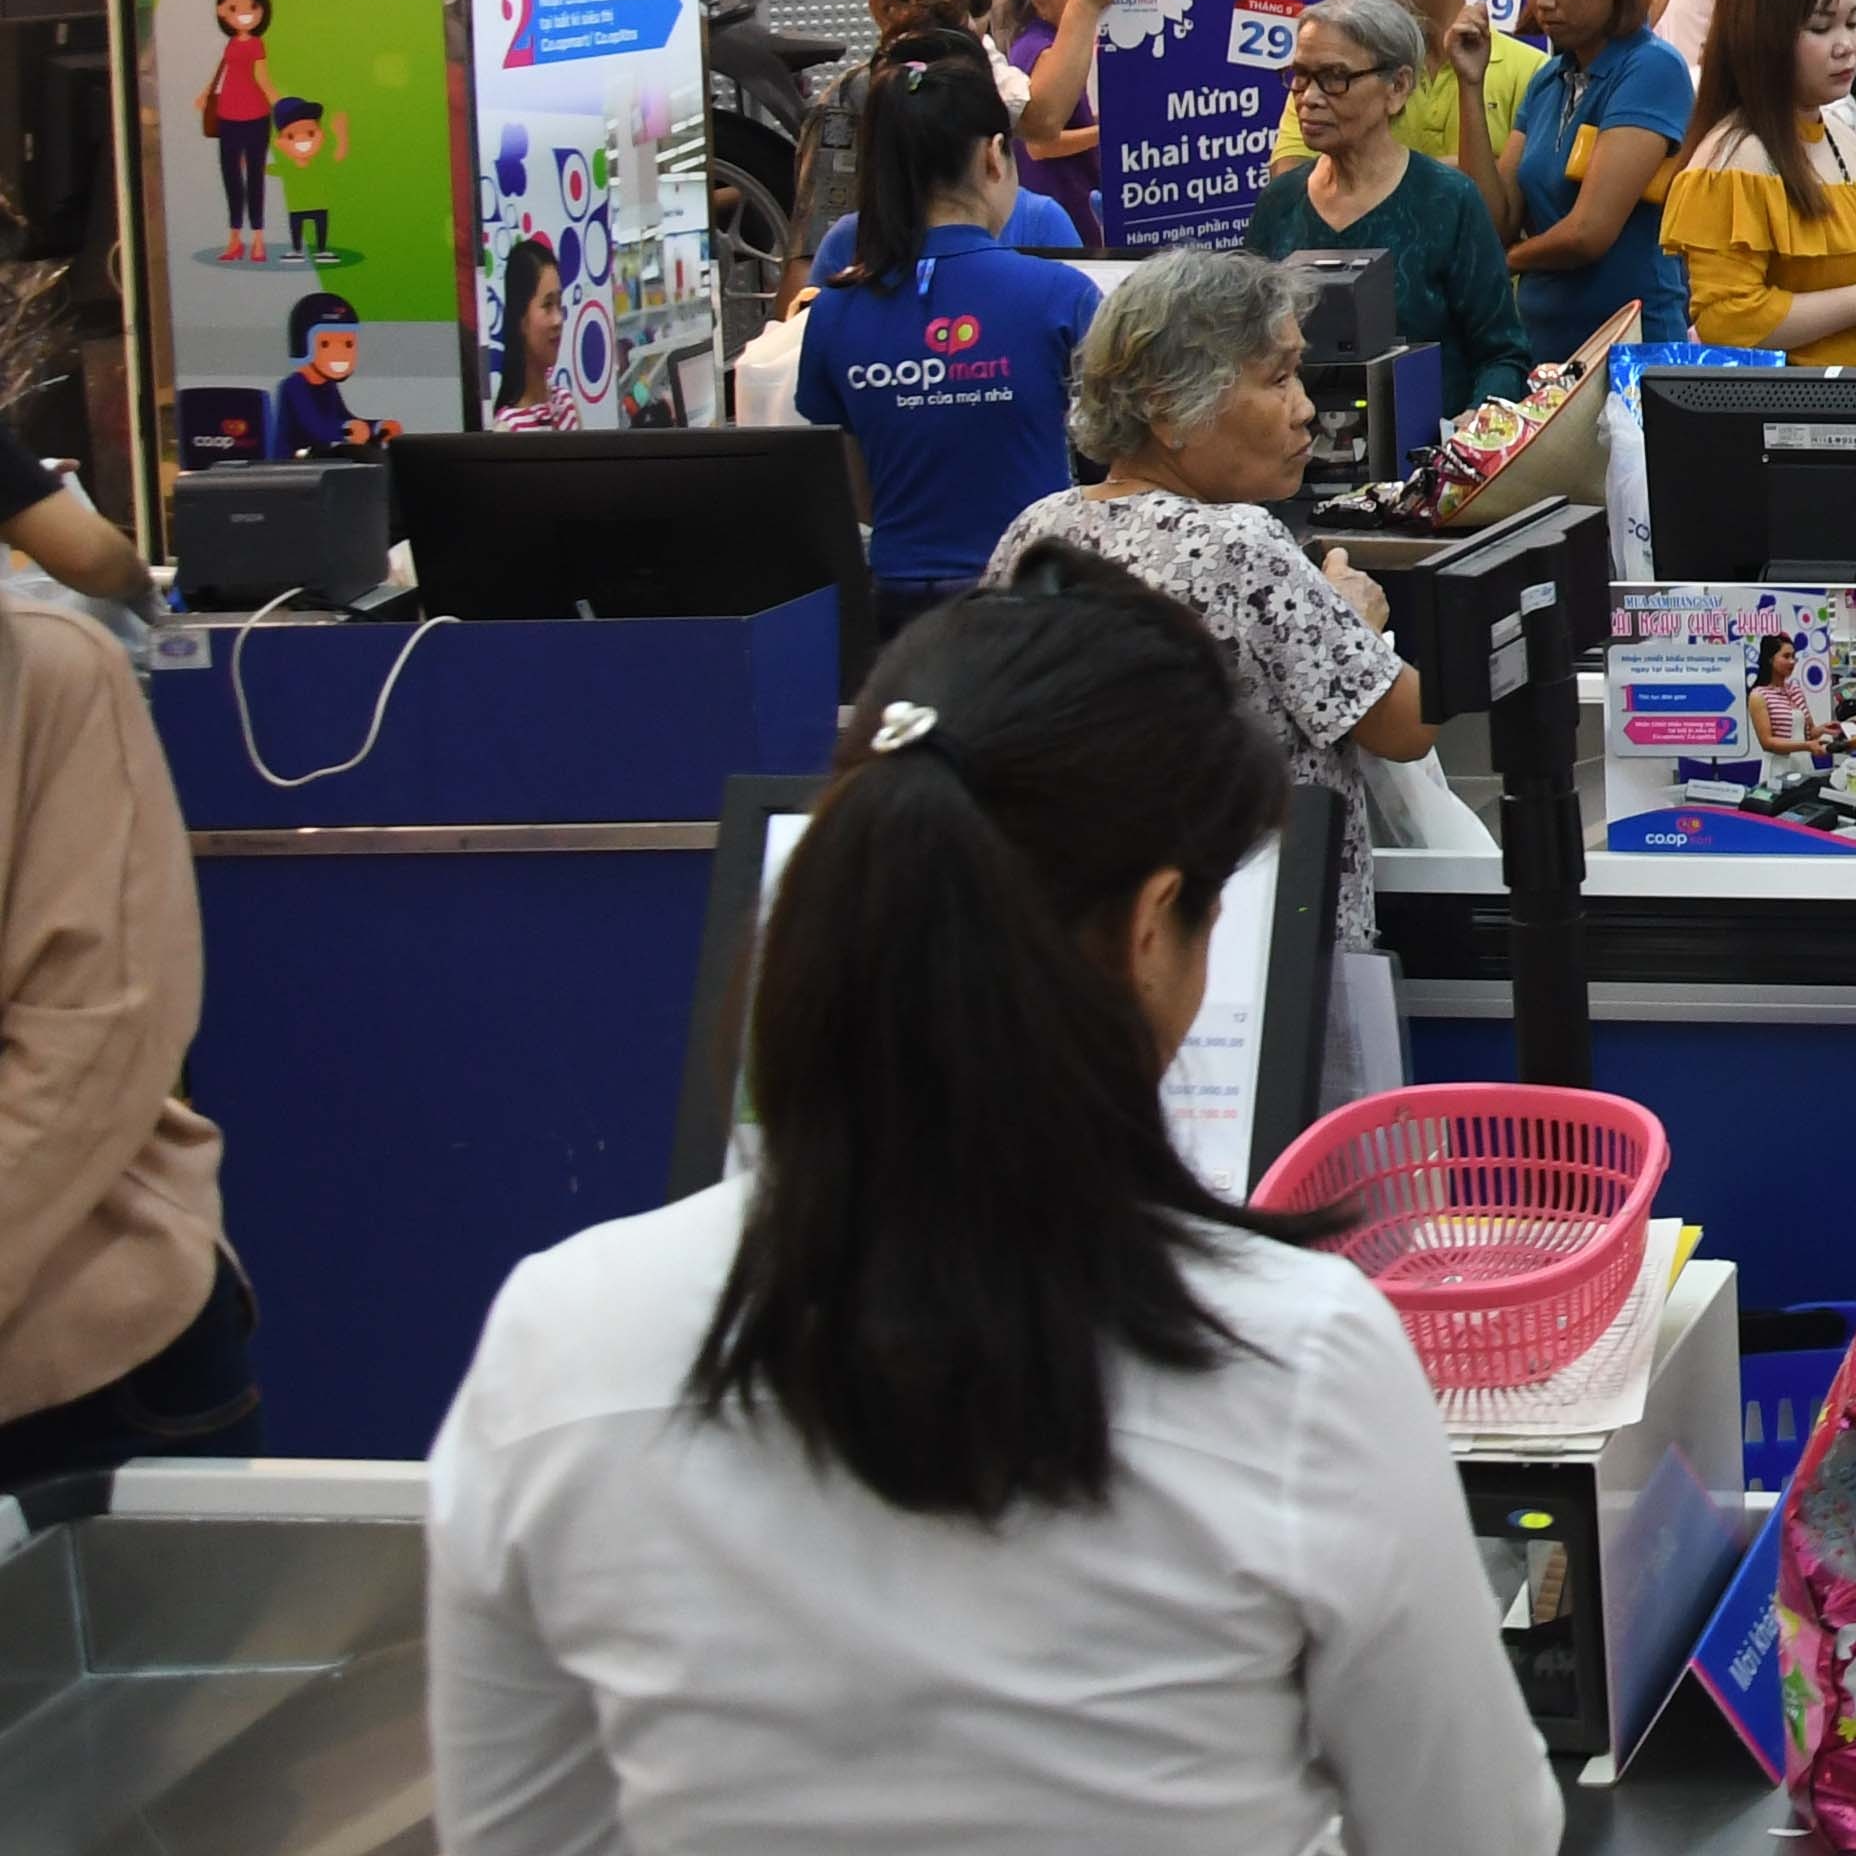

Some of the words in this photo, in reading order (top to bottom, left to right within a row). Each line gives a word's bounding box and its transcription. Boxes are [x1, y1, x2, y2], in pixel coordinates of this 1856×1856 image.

[1285, 6, 1293, 16] 9
[1238, 20, 1293, 60] 29
[1167, 86, 1259, 122] Mừng
[1121, 135, 1189, 173] khai
[1121, 179, 1179, 209] Đón
[1187, 167, 1239, 204] quà
[1127, 231, 1159, 246] Hàng
[1163, 224, 1194, 241] ngàn
[1197, 218, 1229, 236] phần
[1232, 217, 1250, 232] qu
[897, 394, 924, 410] bạn
[927, 390, 953, 405] của
[956, 389, 981, 406] mọi
[984, 386, 1013, 402] nhà
[1638, 611, 1682, 637] NGAY
[1718, 717, 1738, 745] 2
